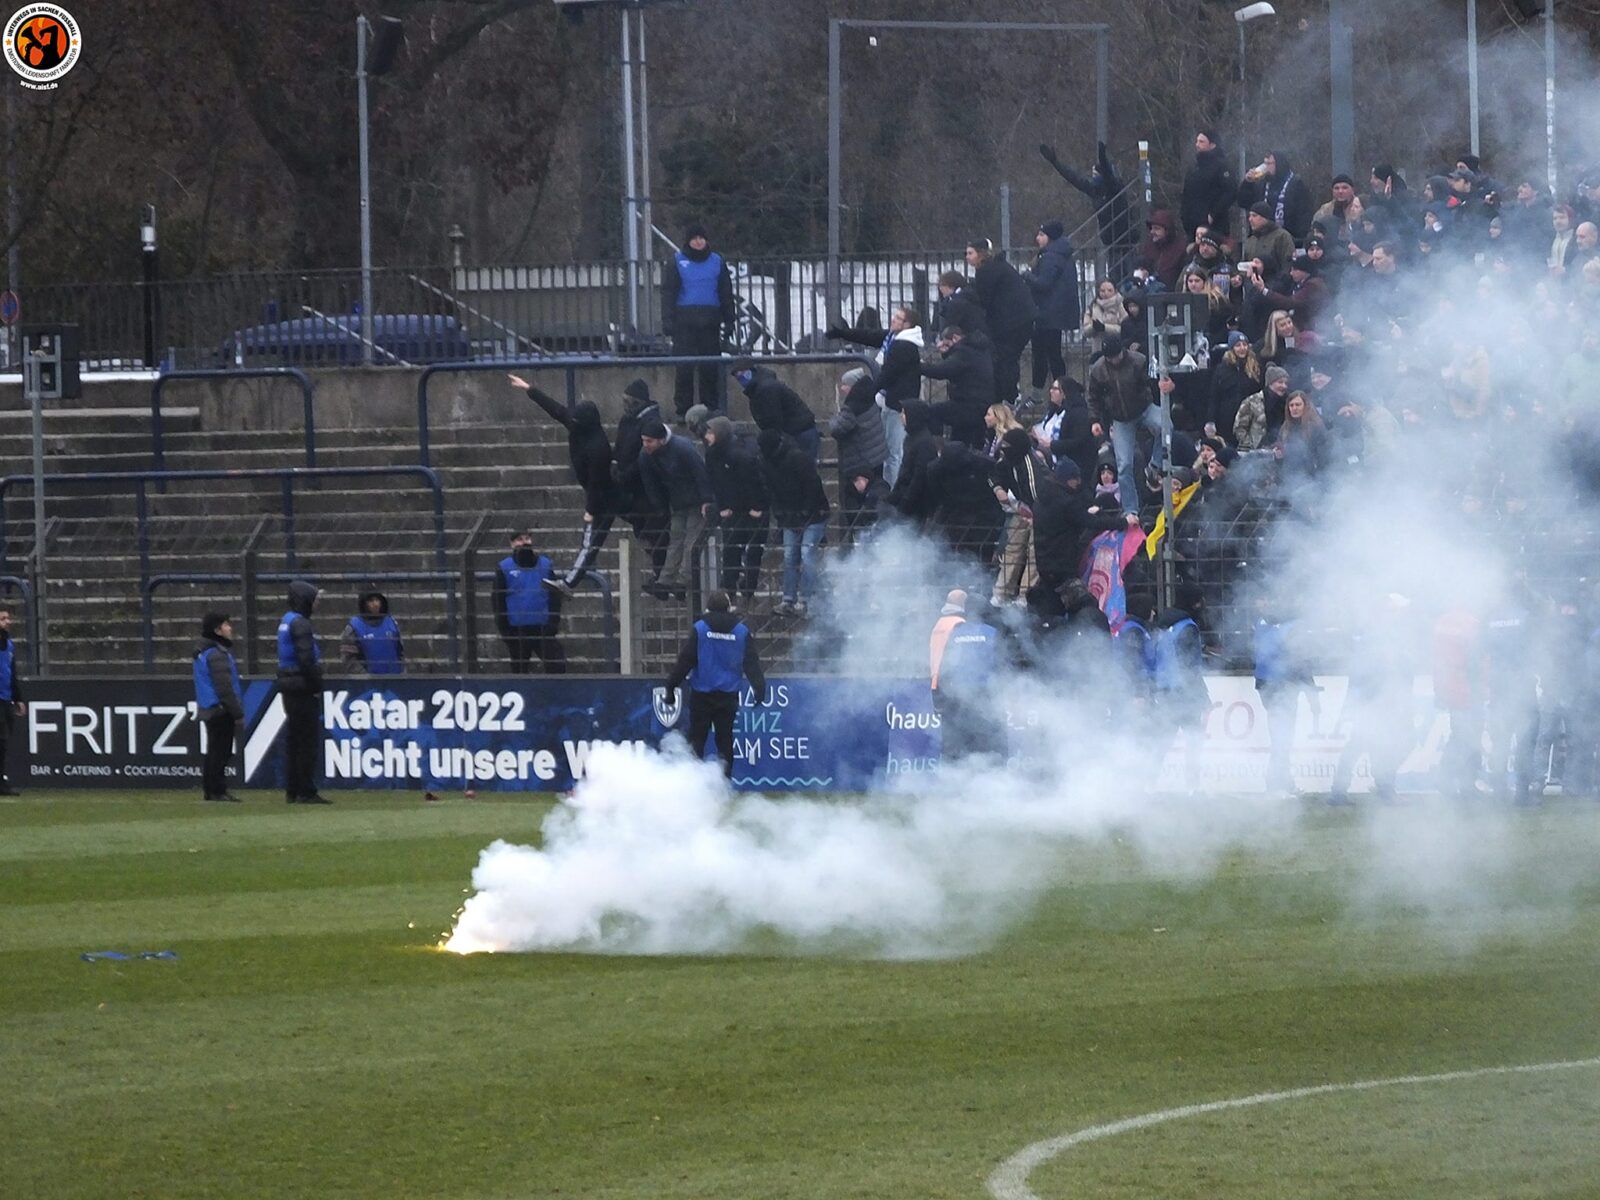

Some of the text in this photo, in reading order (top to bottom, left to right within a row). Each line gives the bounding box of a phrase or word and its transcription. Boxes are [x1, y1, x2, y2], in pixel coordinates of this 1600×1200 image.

[738, 685, 789, 708] AUS
[323, 690, 525, 731] Katar 2022
[712, 711, 782, 733] EINZ
[324, 738, 421, 778] Nicht
[429, 748, 557, 780] unsere
[769, 737, 810, 759] SEE
[30, 764, 51, 776] BAR
[63, 764, 112, 776] CATERING
